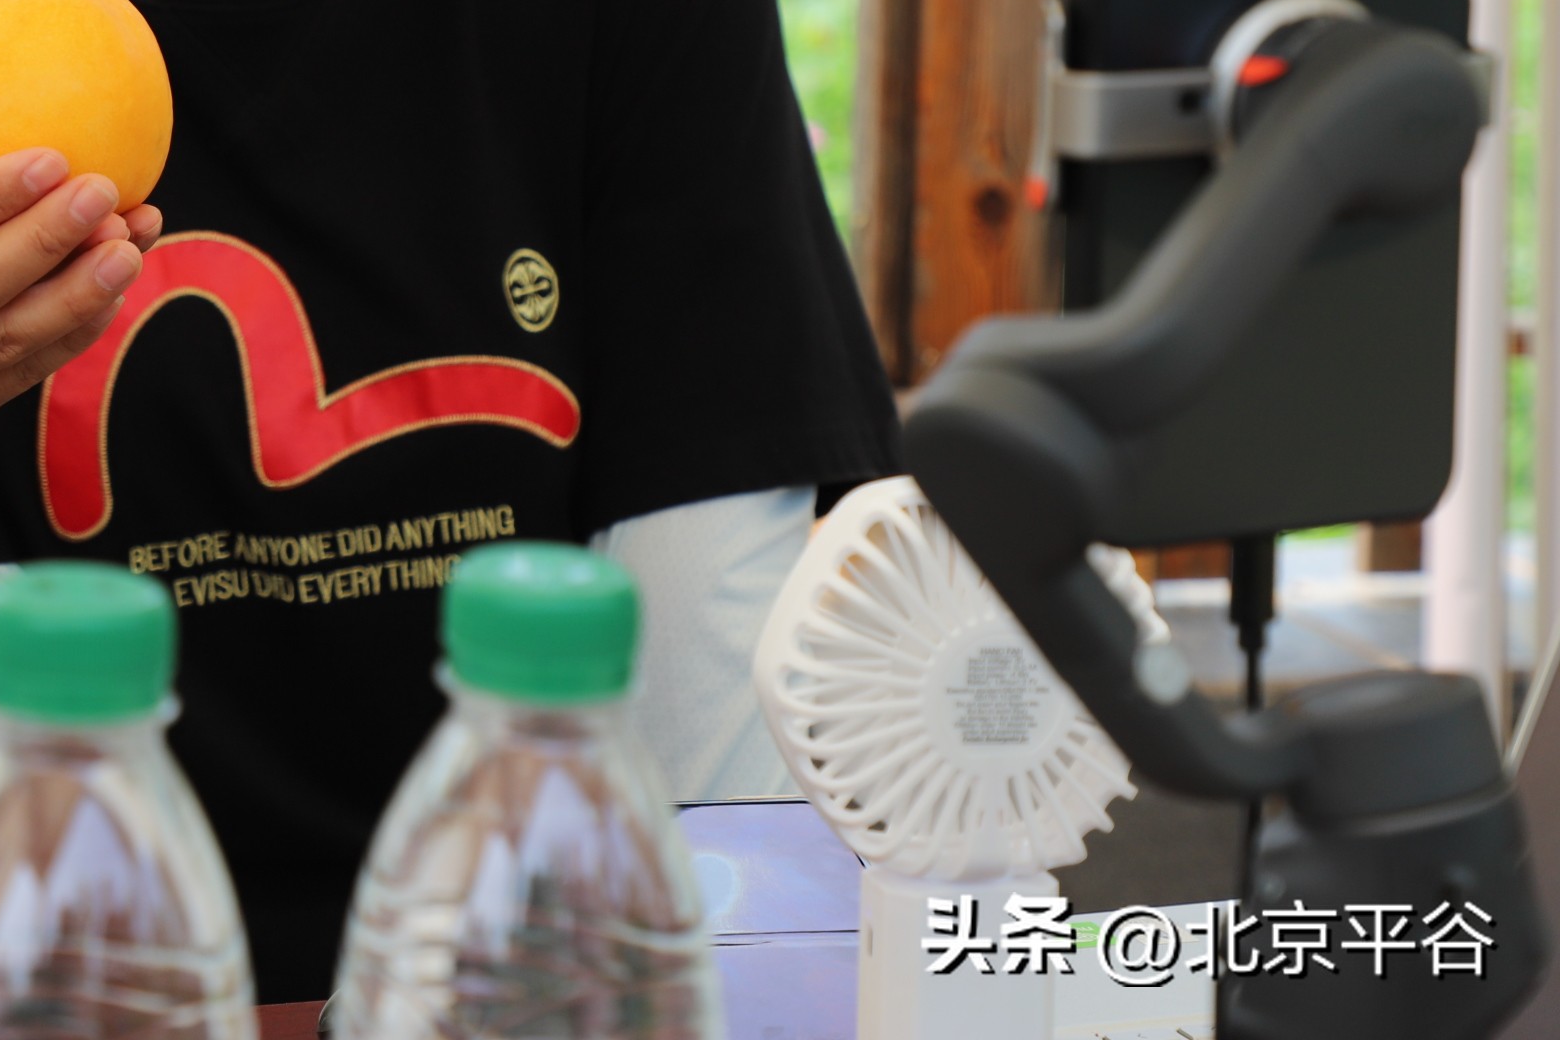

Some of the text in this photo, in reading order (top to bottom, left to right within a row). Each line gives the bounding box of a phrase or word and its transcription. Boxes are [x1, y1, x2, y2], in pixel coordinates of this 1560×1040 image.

[129, 504, 515, 575] BEFORE ANYONE DID ANYTHING
[173, 569, 250, 608] EVISU
[252, 570, 295, 603] DID
